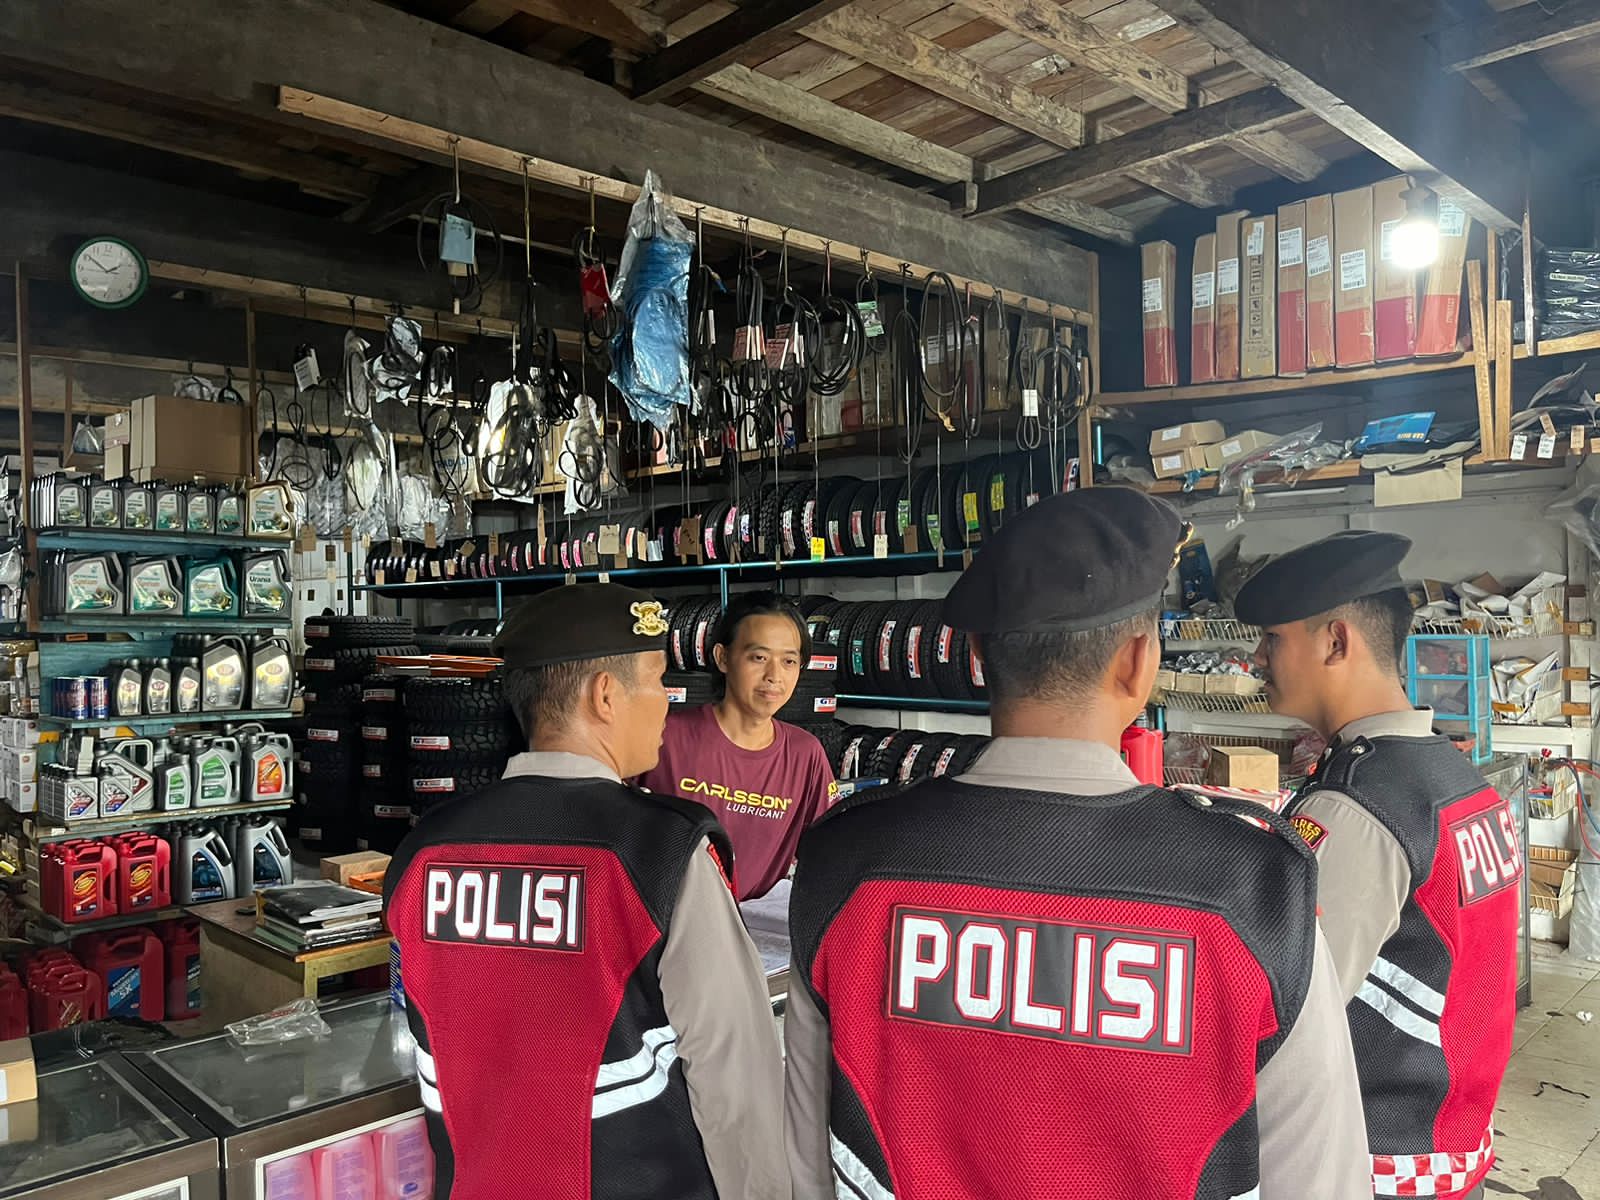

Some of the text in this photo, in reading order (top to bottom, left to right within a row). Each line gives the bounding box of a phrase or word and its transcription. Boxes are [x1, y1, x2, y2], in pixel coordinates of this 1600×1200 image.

[250, 576, 271, 584] Urania
[680, 778, 789, 810] CARLSSON
[726, 802, 785, 820] LUBRICANT
[1291, 818, 1322, 836] LRES
[427, 870, 579, 946] POLISI
[898, 915, 1187, 1045] POLISI
